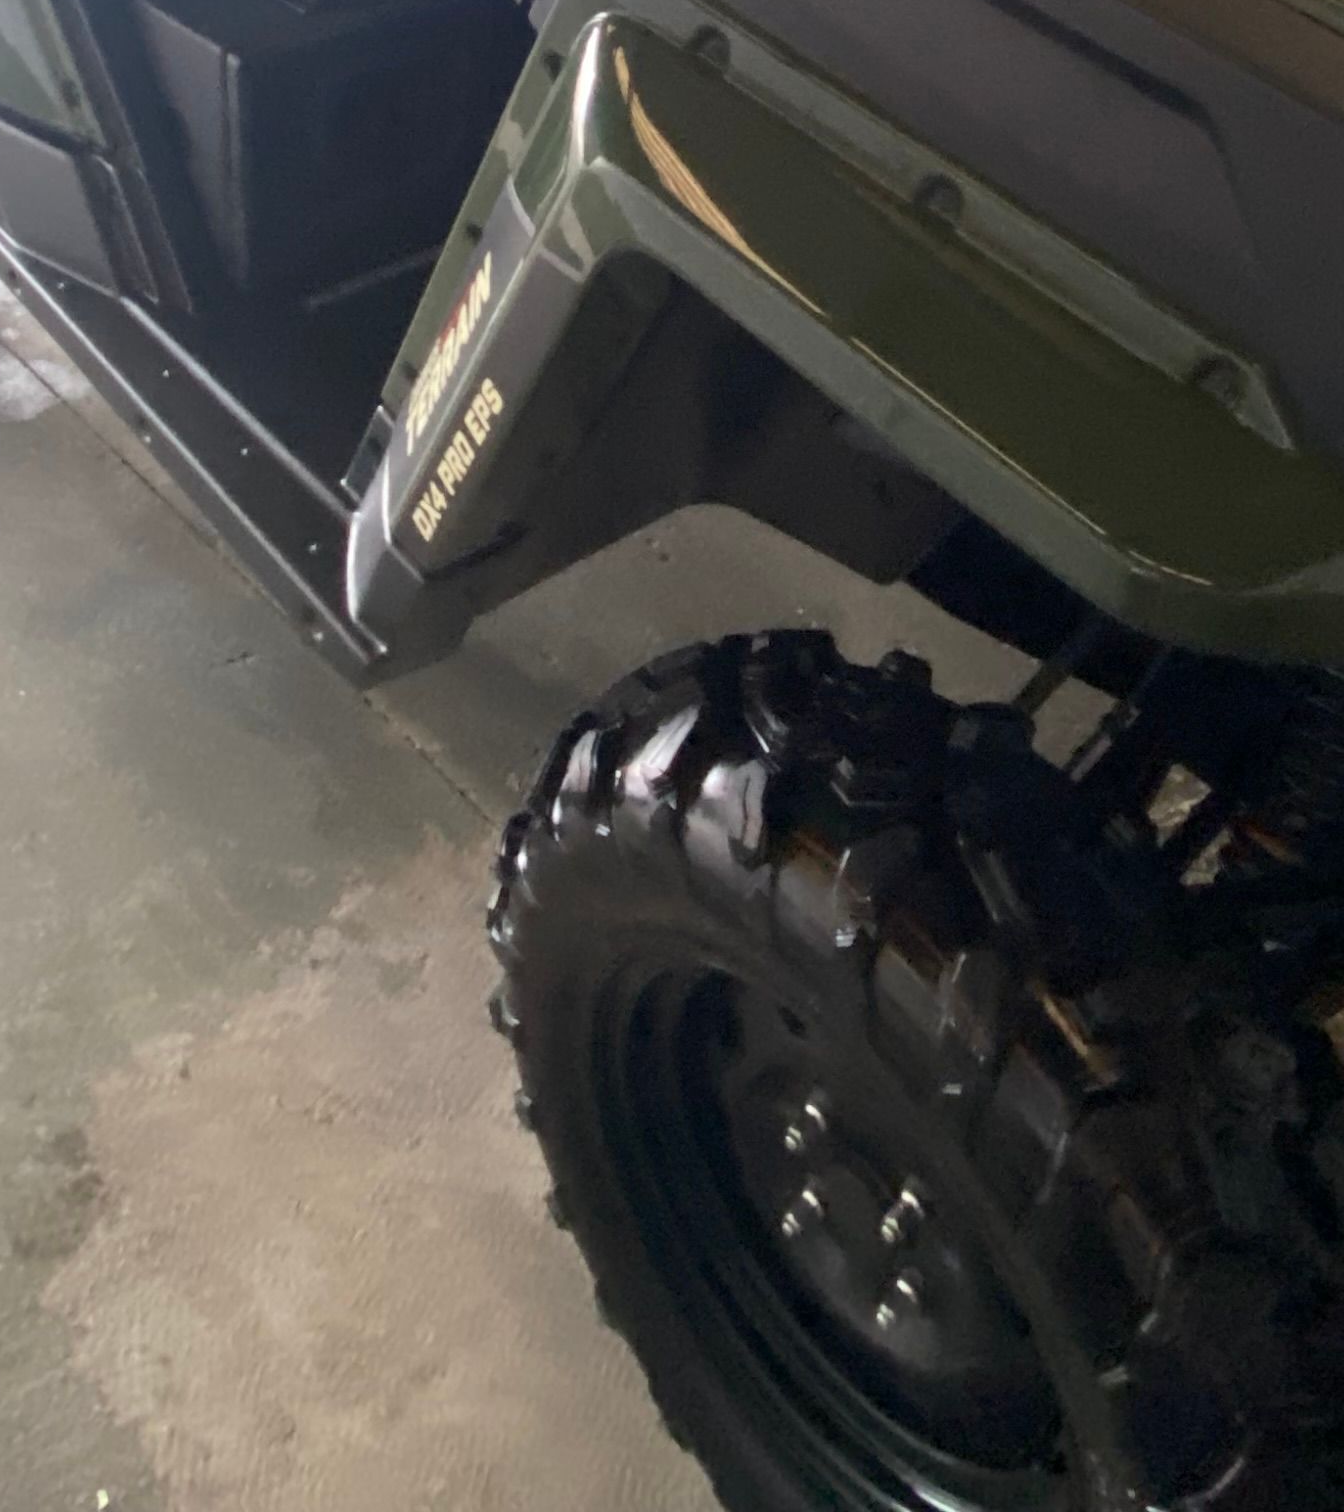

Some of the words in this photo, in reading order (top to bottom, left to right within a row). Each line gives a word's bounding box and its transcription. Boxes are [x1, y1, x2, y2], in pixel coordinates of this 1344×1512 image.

[406, 250, 492, 457] TERRAIN
[412, 480, 447, 542] DX4
[437, 430, 475, 496] PRO
[464, 377, 504, 445] EPS
